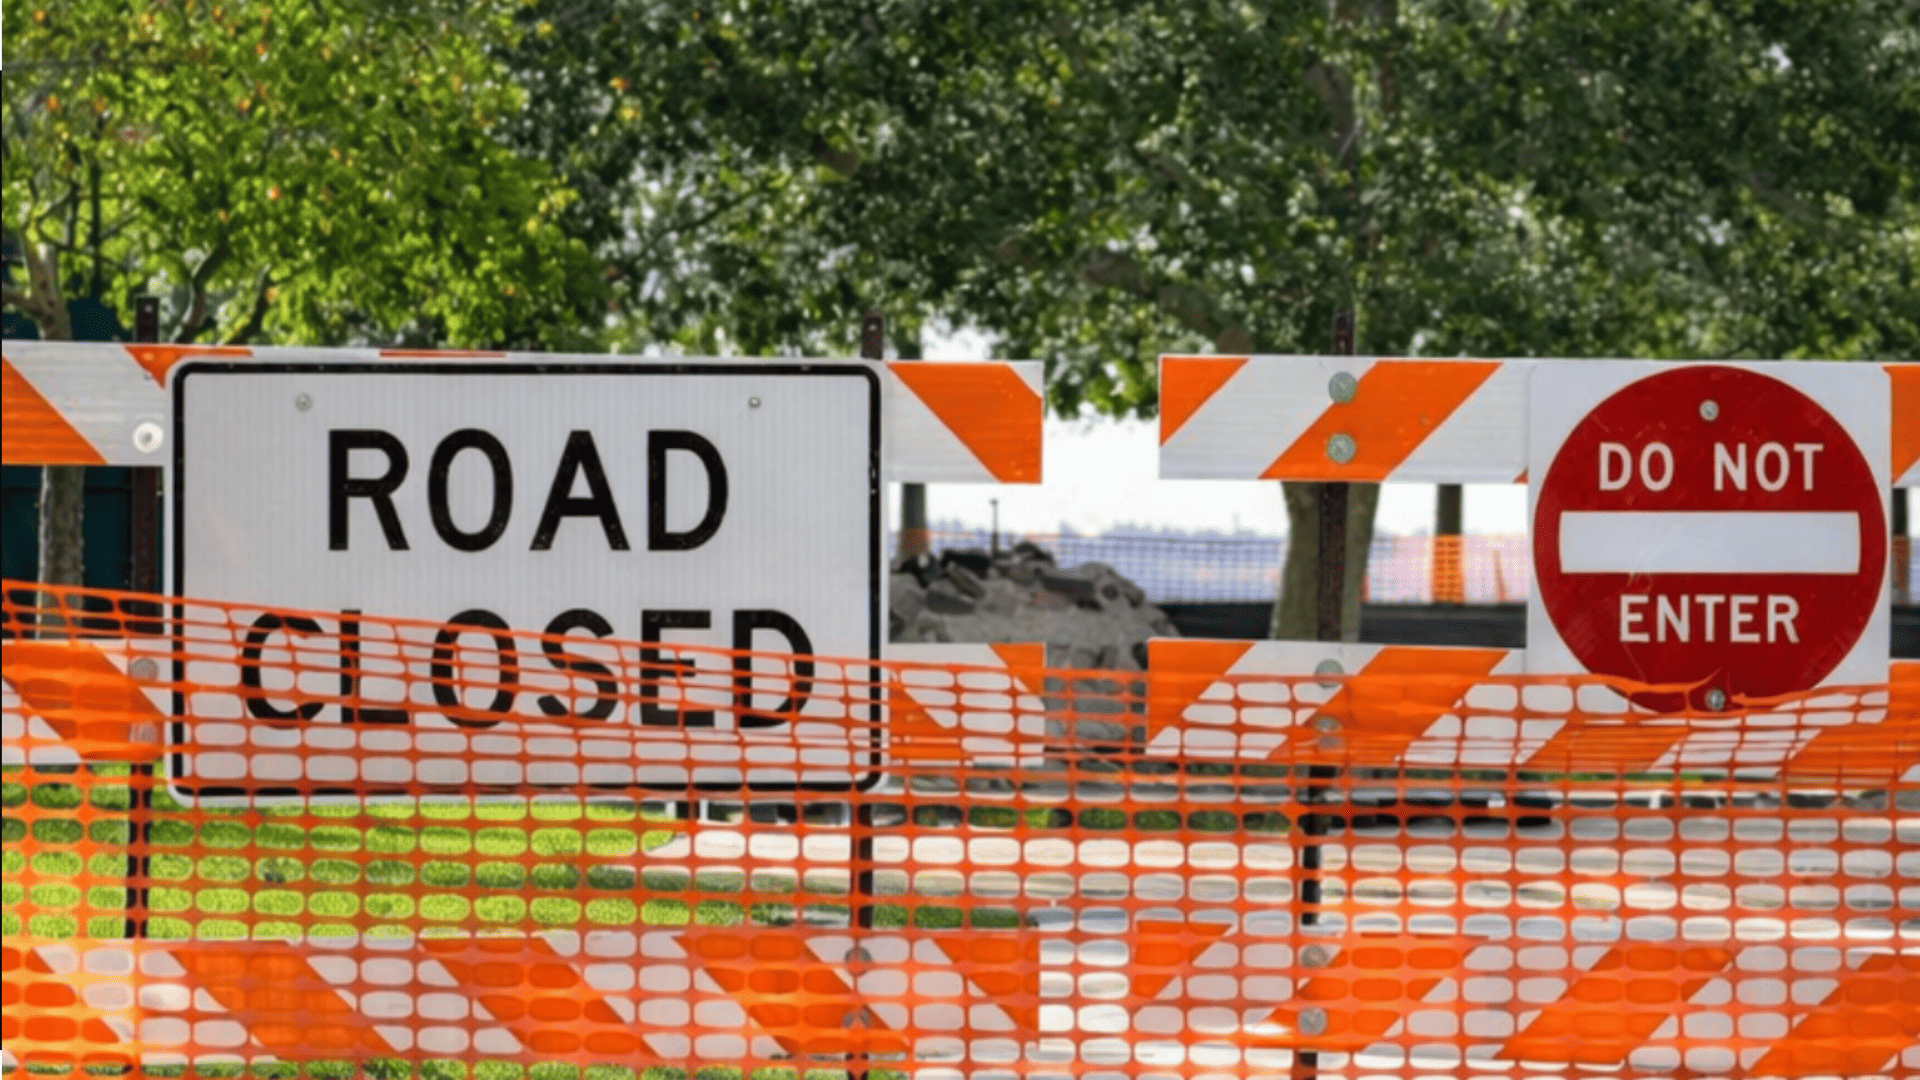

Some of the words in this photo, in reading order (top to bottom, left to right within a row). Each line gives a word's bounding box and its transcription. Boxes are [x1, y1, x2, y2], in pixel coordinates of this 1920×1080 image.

[327, 428, 729, 552] ROAD
[1599, 442, 1674, 492] DO
[1714, 442, 1824, 492] NOT
[1619, 594, 1800, 643] ENTER
[240, 608, 815, 729] CLOSED
